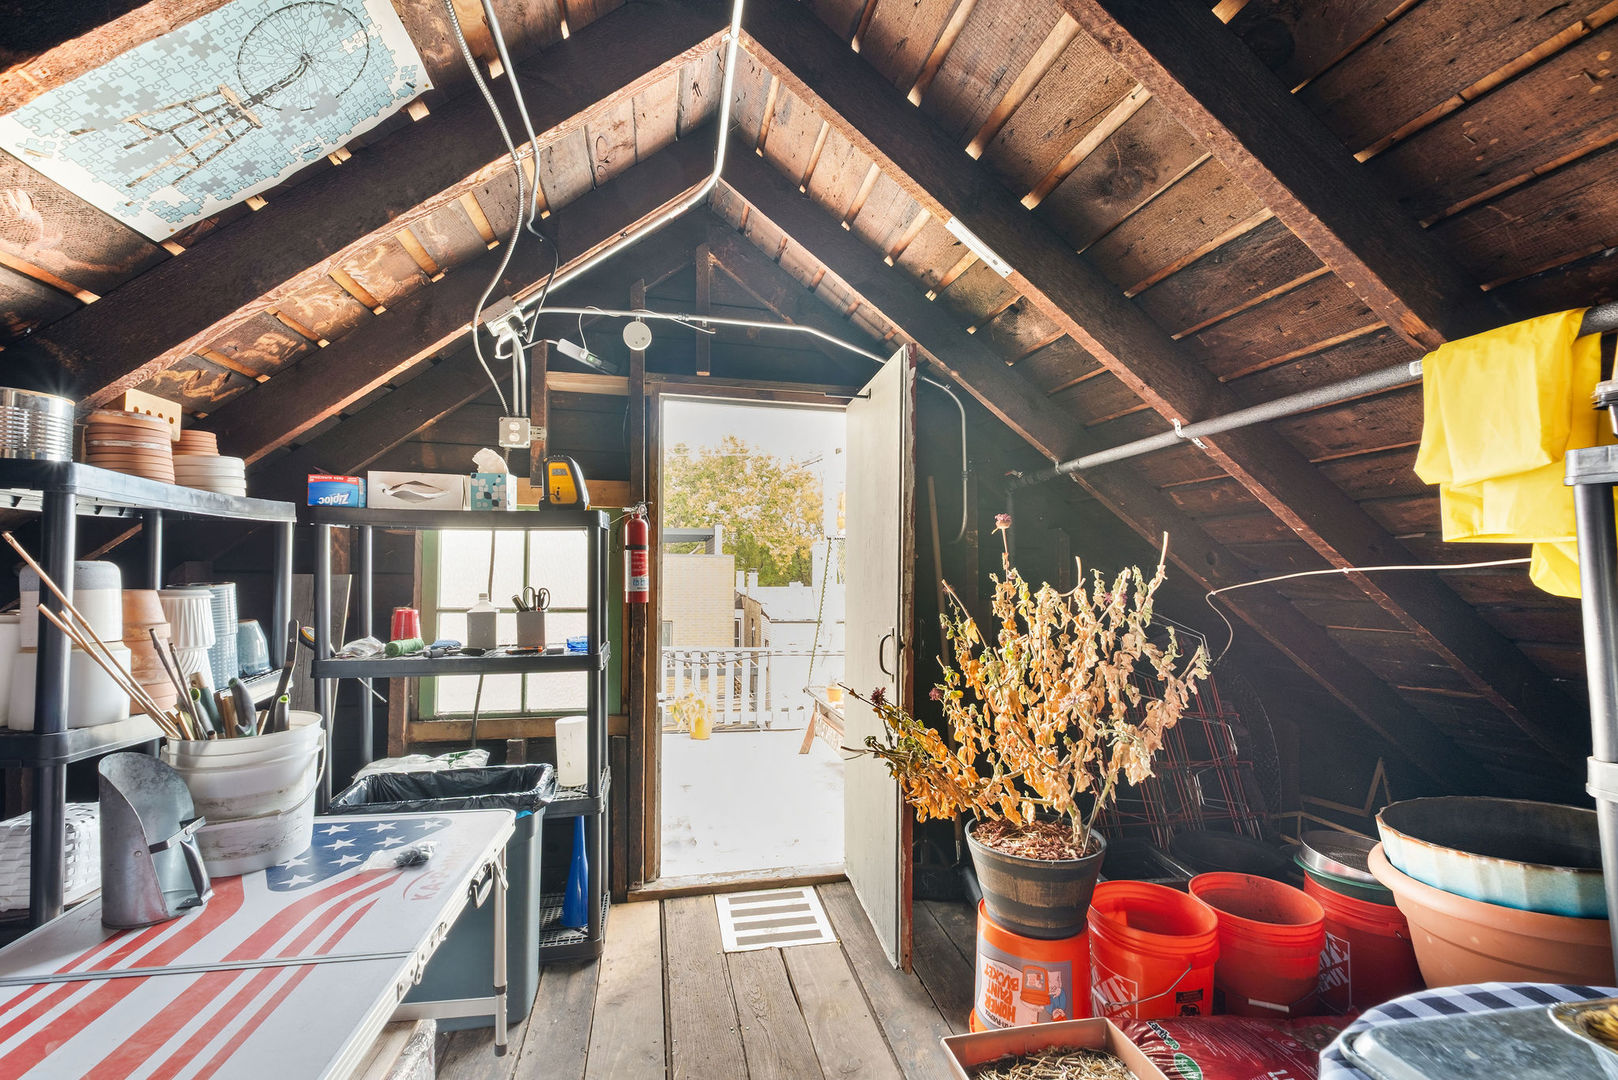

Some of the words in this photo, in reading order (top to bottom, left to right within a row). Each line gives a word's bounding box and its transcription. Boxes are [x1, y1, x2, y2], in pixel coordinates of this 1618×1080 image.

[318, 493, 349, 505] Ziploc
[984, 963, 1019, 991] BUCKET
[987, 978, 1013, 1006] PAINT
[984, 993, 1017, 1023] HOMER
